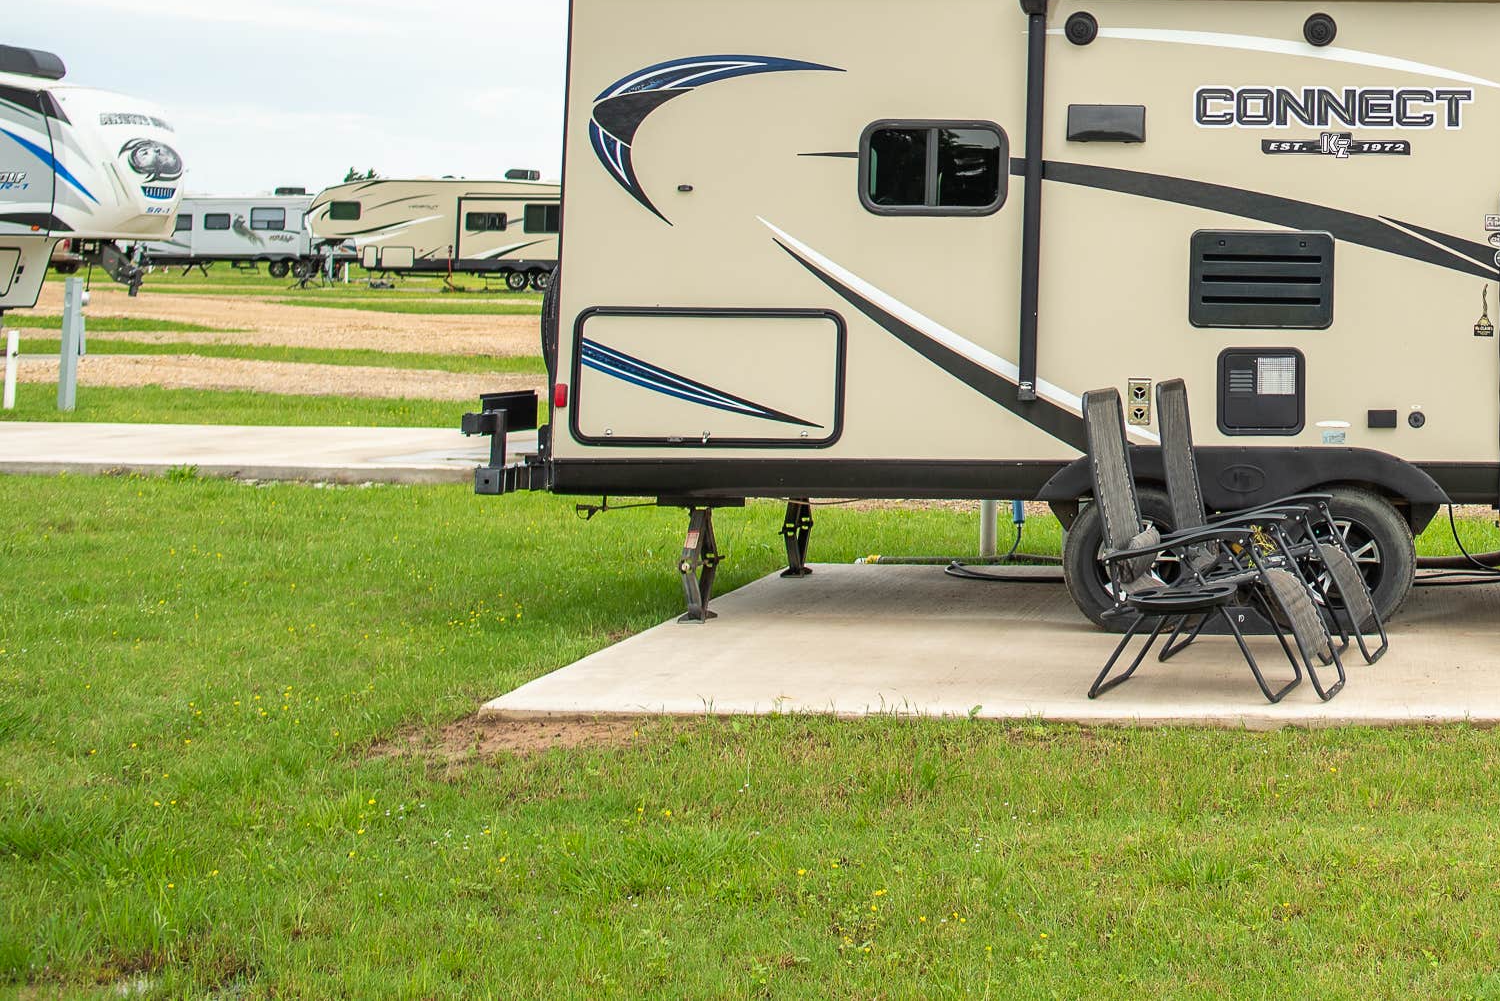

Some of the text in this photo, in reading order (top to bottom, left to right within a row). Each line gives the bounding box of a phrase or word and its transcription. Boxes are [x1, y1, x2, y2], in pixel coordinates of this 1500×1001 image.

[1195, 87, 1474, 128] CONNECT
[1269, 142, 1307, 151] EST.
[1361, 143, 1405, 152] 1972
[145, 206, 170, 214] SR-1
